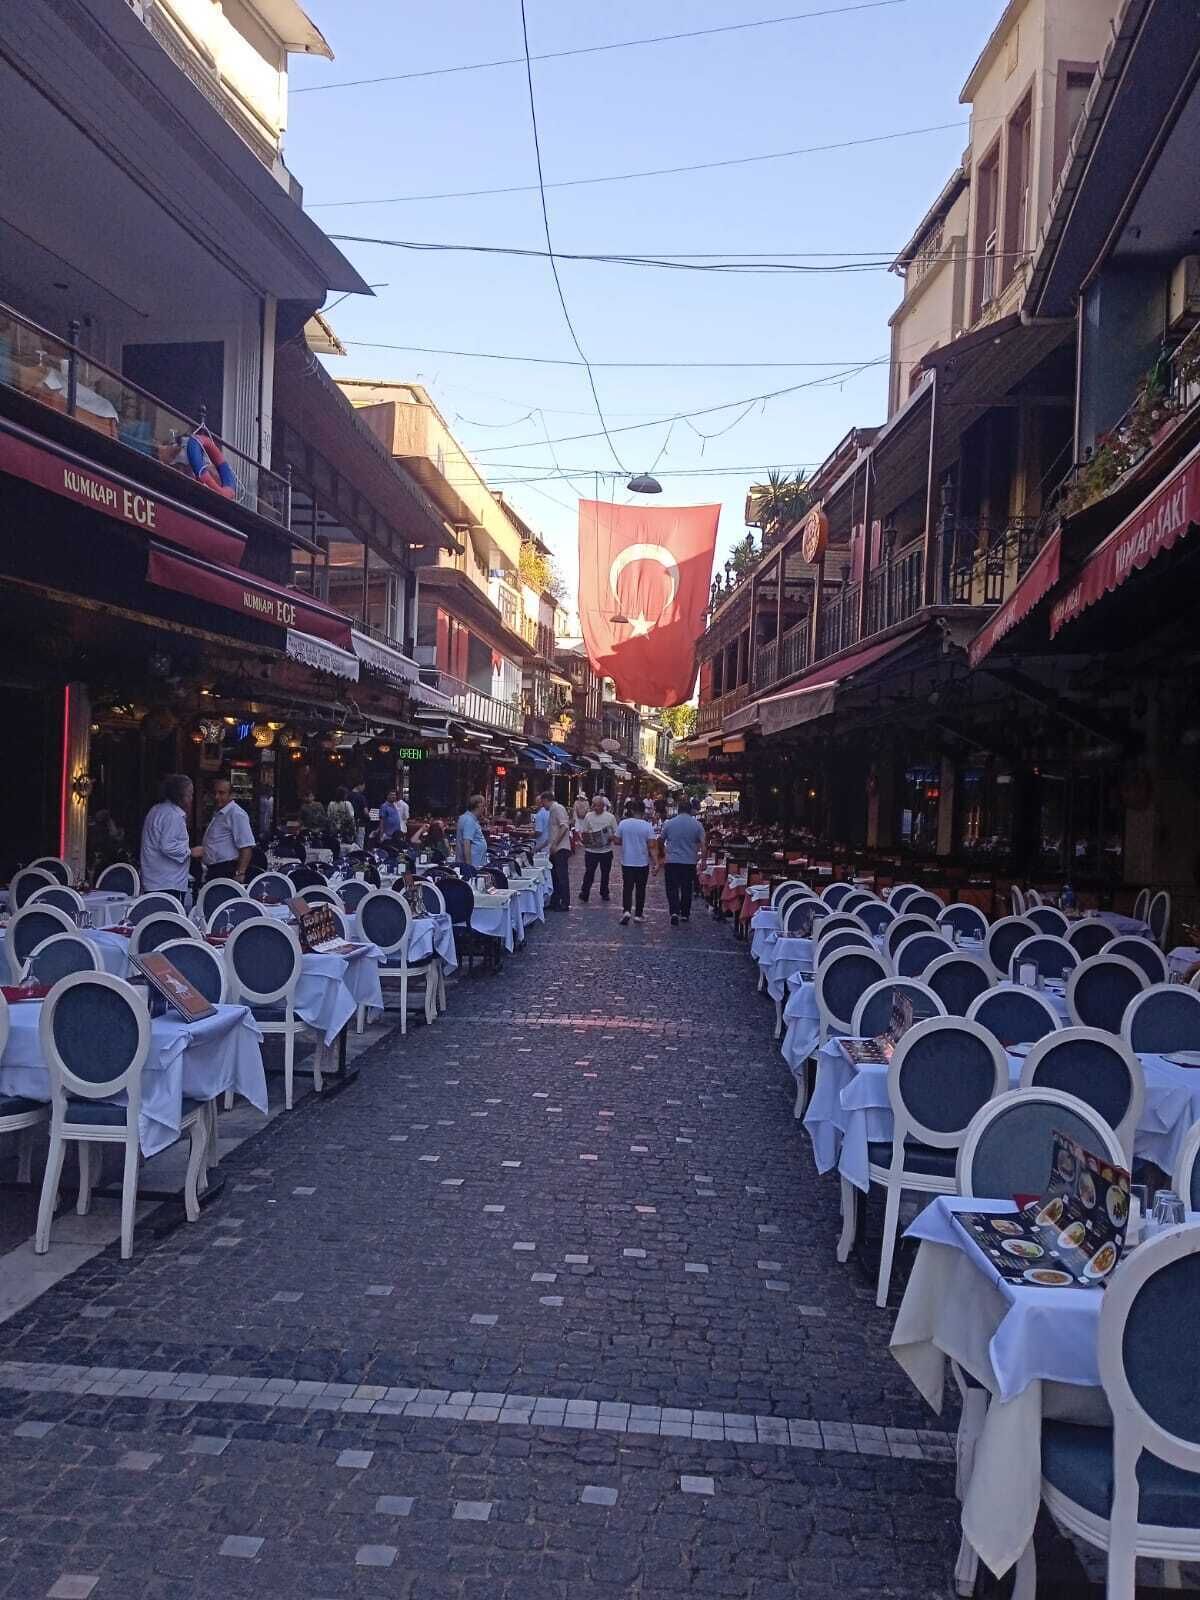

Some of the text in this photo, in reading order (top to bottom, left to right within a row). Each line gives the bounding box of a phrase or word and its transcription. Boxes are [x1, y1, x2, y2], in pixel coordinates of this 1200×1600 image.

[64, 469, 156, 528] KUMKAPI EGE
[277, 600, 297, 625] EGE
[399, 748, 422, 760] GREEN
